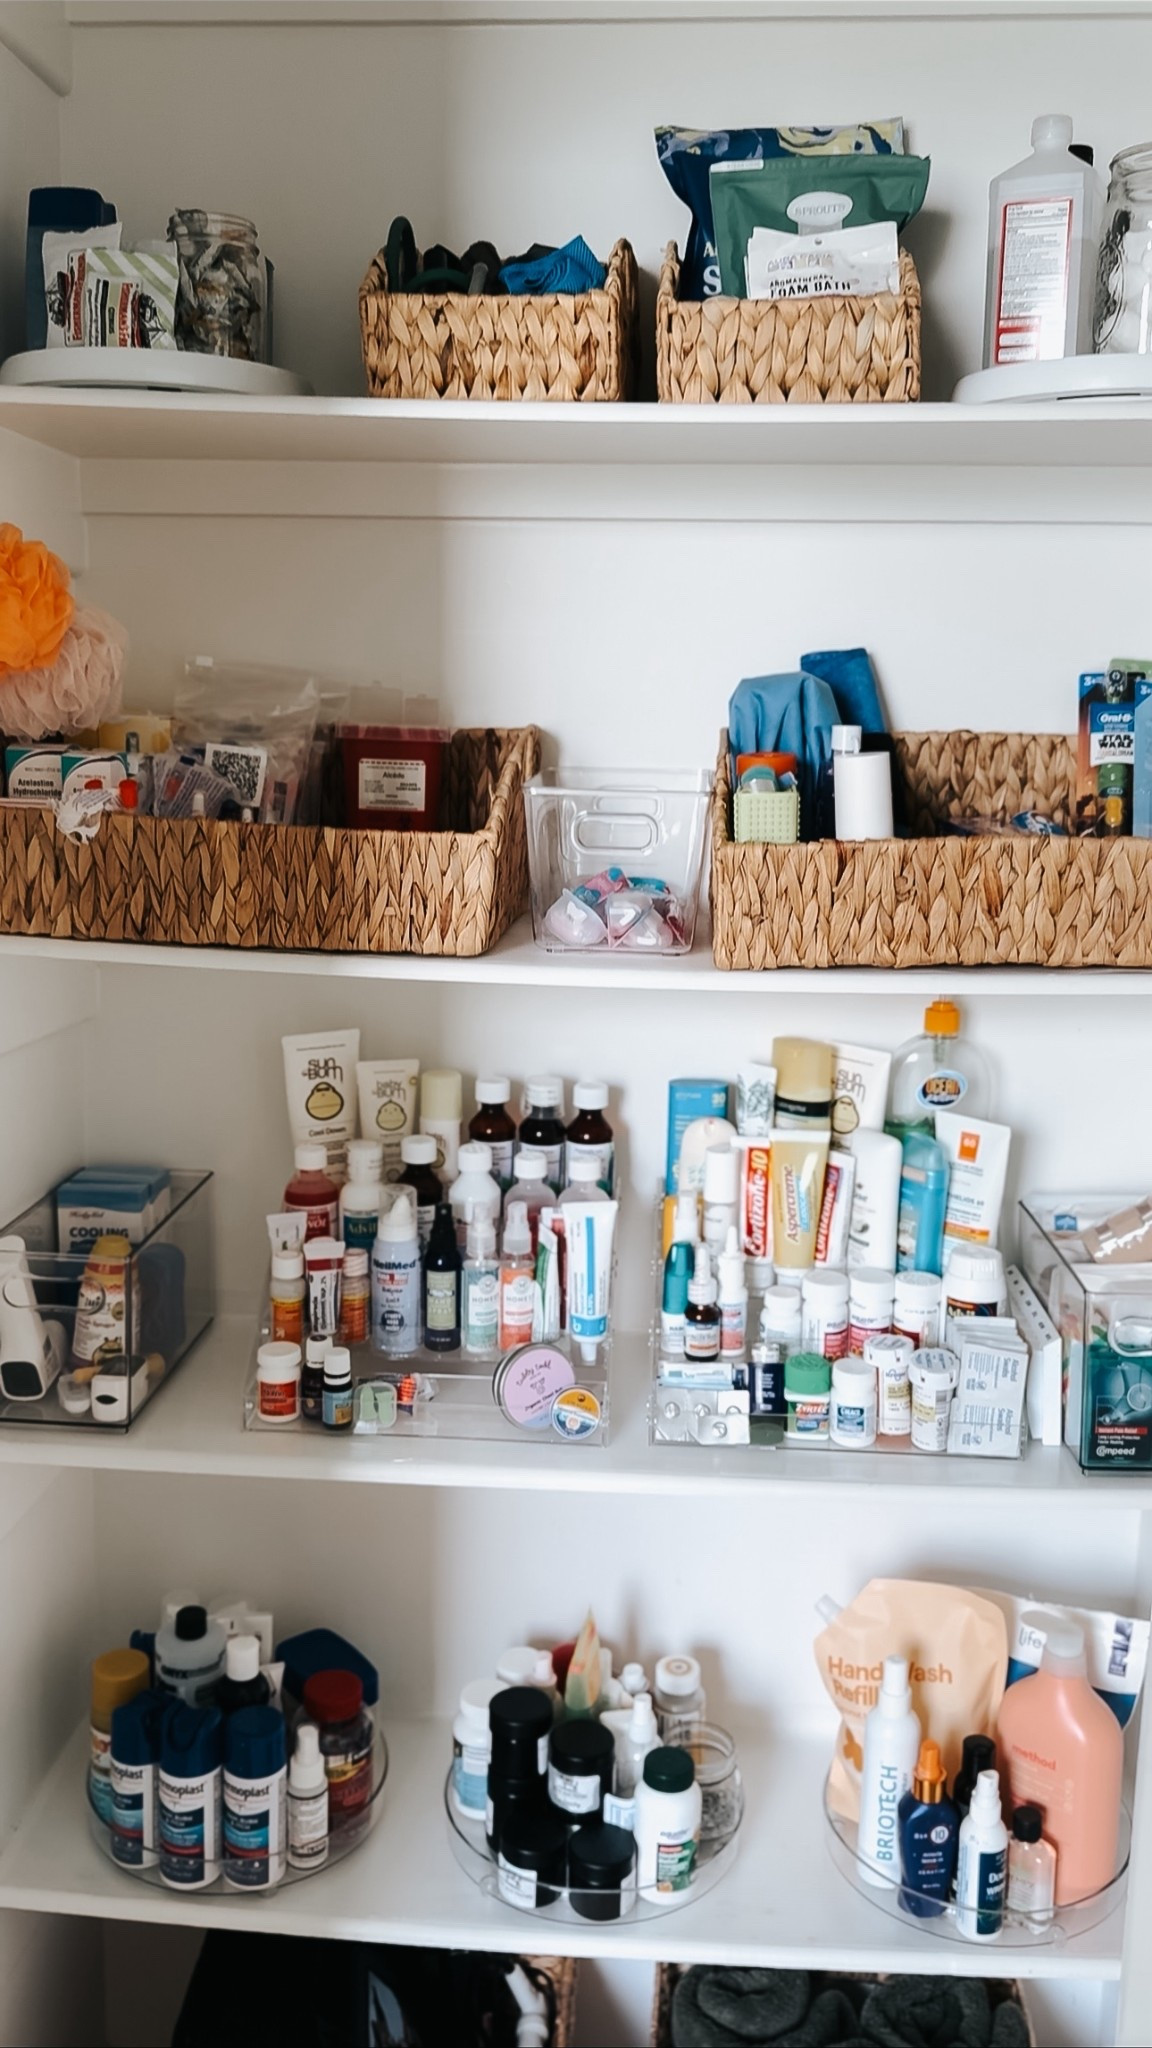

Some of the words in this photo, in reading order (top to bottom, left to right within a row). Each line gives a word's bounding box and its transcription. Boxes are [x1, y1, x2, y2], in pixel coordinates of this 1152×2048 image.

[794, 205, 846, 217] SPROUTS
[1100, 713, 1133, 724] Oral-B
[1098, 739, 1133, 749] WARS
[1102, 734, 1131, 744] STAR
[307, 1057, 336, 1070] sun
[746, 1149, 769, 1257] Cortizone-10
[784, 1165, 800, 1243] Aspercreme
[69, 1226, 129, 1239] COOLING
[373, 1258, 416, 1270] NeilMed
[828, 1656, 884, 1683] Hand
[833, 1680, 880, 1707] Refill
[1011, 1744, 1057, 1772] method
[876, 1765, 899, 1862] BRIOTECH
